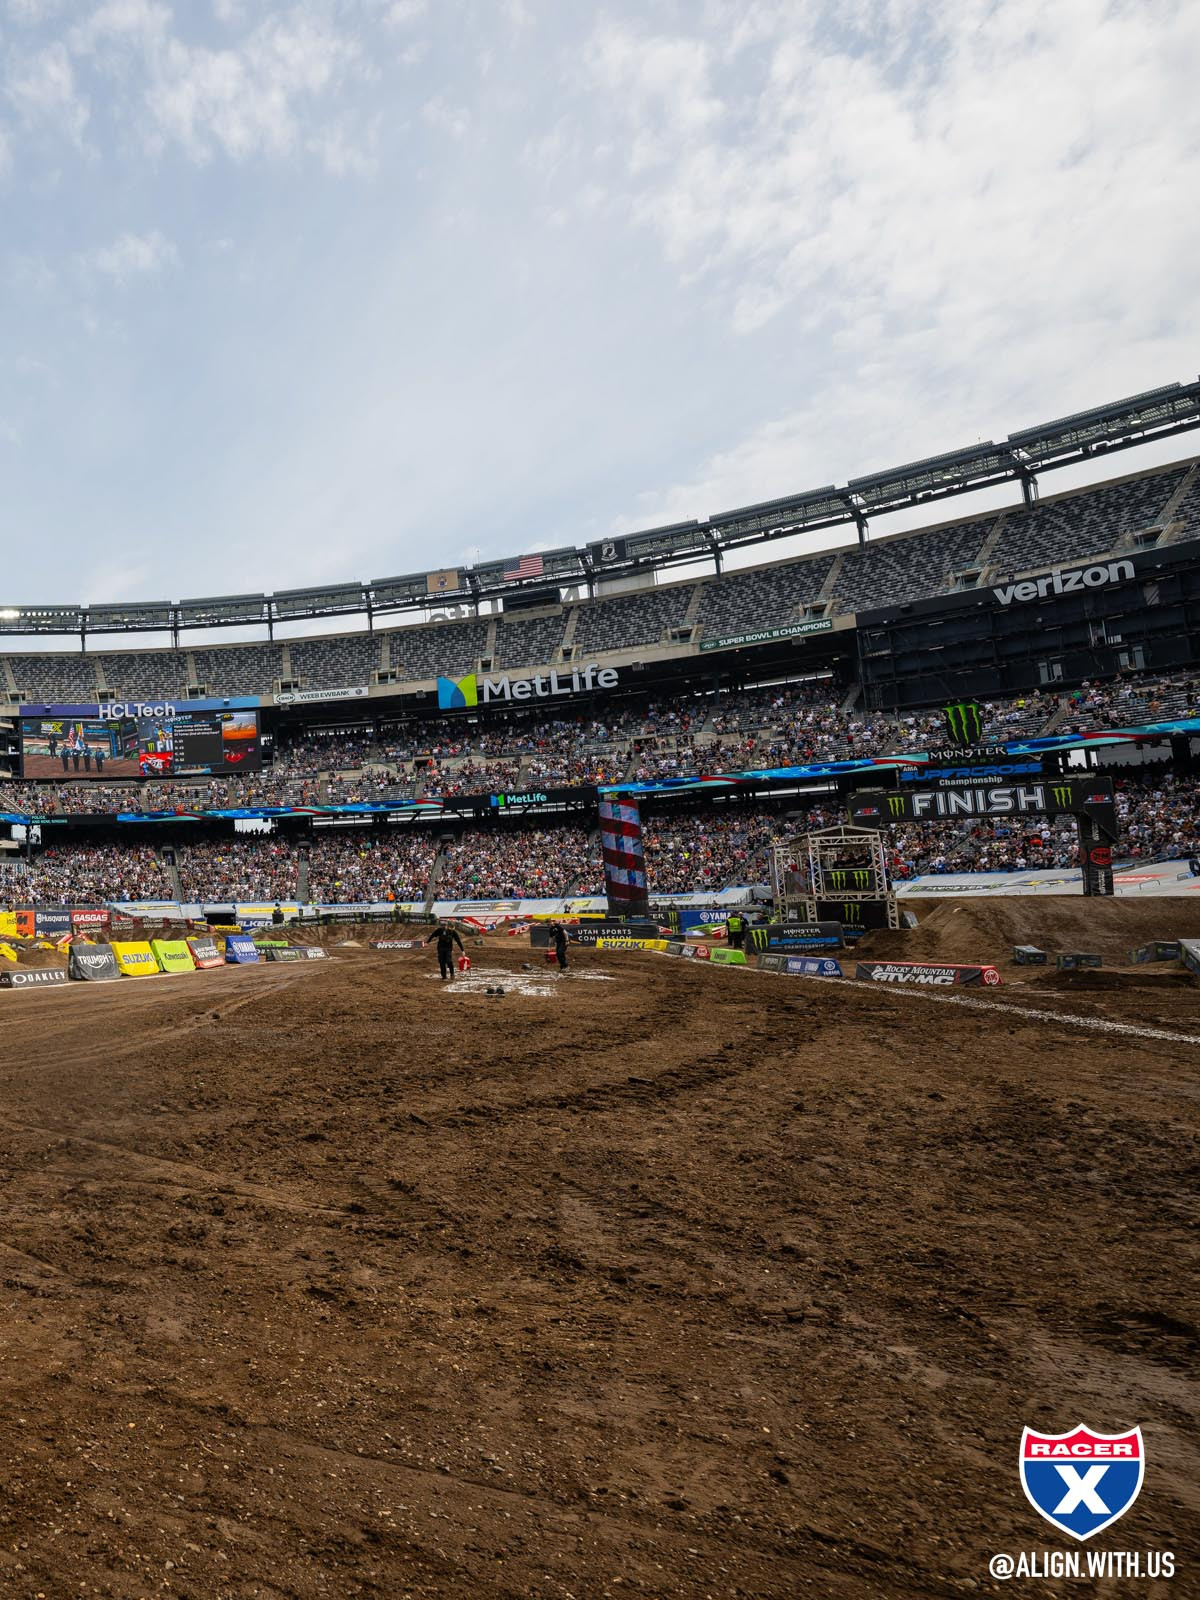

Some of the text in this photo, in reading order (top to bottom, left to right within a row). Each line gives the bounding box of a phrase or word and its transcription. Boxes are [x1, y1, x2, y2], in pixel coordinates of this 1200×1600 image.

[993, 560, 1136, 606] verizon
[718, 636, 745, 647] SUPER
[745, 632, 772, 642] BOWL
[779, 620, 832, 636] CHAMPIONS
[483, 663, 620, 703] MetLife
[98, 702, 177, 719] HCLTech
[929, 745, 1008, 761] MONSTER
[939, 775, 1003, 786] Championship
[507, 792, 547, 804] MetLife
[912, 785, 1046, 817] FINISH
[73, 914, 109, 922] GASGAS
[710, 912, 731, 920] YAMA
[783, 928, 821, 936] MONSTER
[602, 941, 646, 949] SUZUKI
[78, 953, 109, 968] TRIUMPH
[122, 952, 154, 965] SUZUKI
[884, 964, 957, 976] ROCKY MOUNTAIN
[27, 971, 66, 982] OAKLEY
